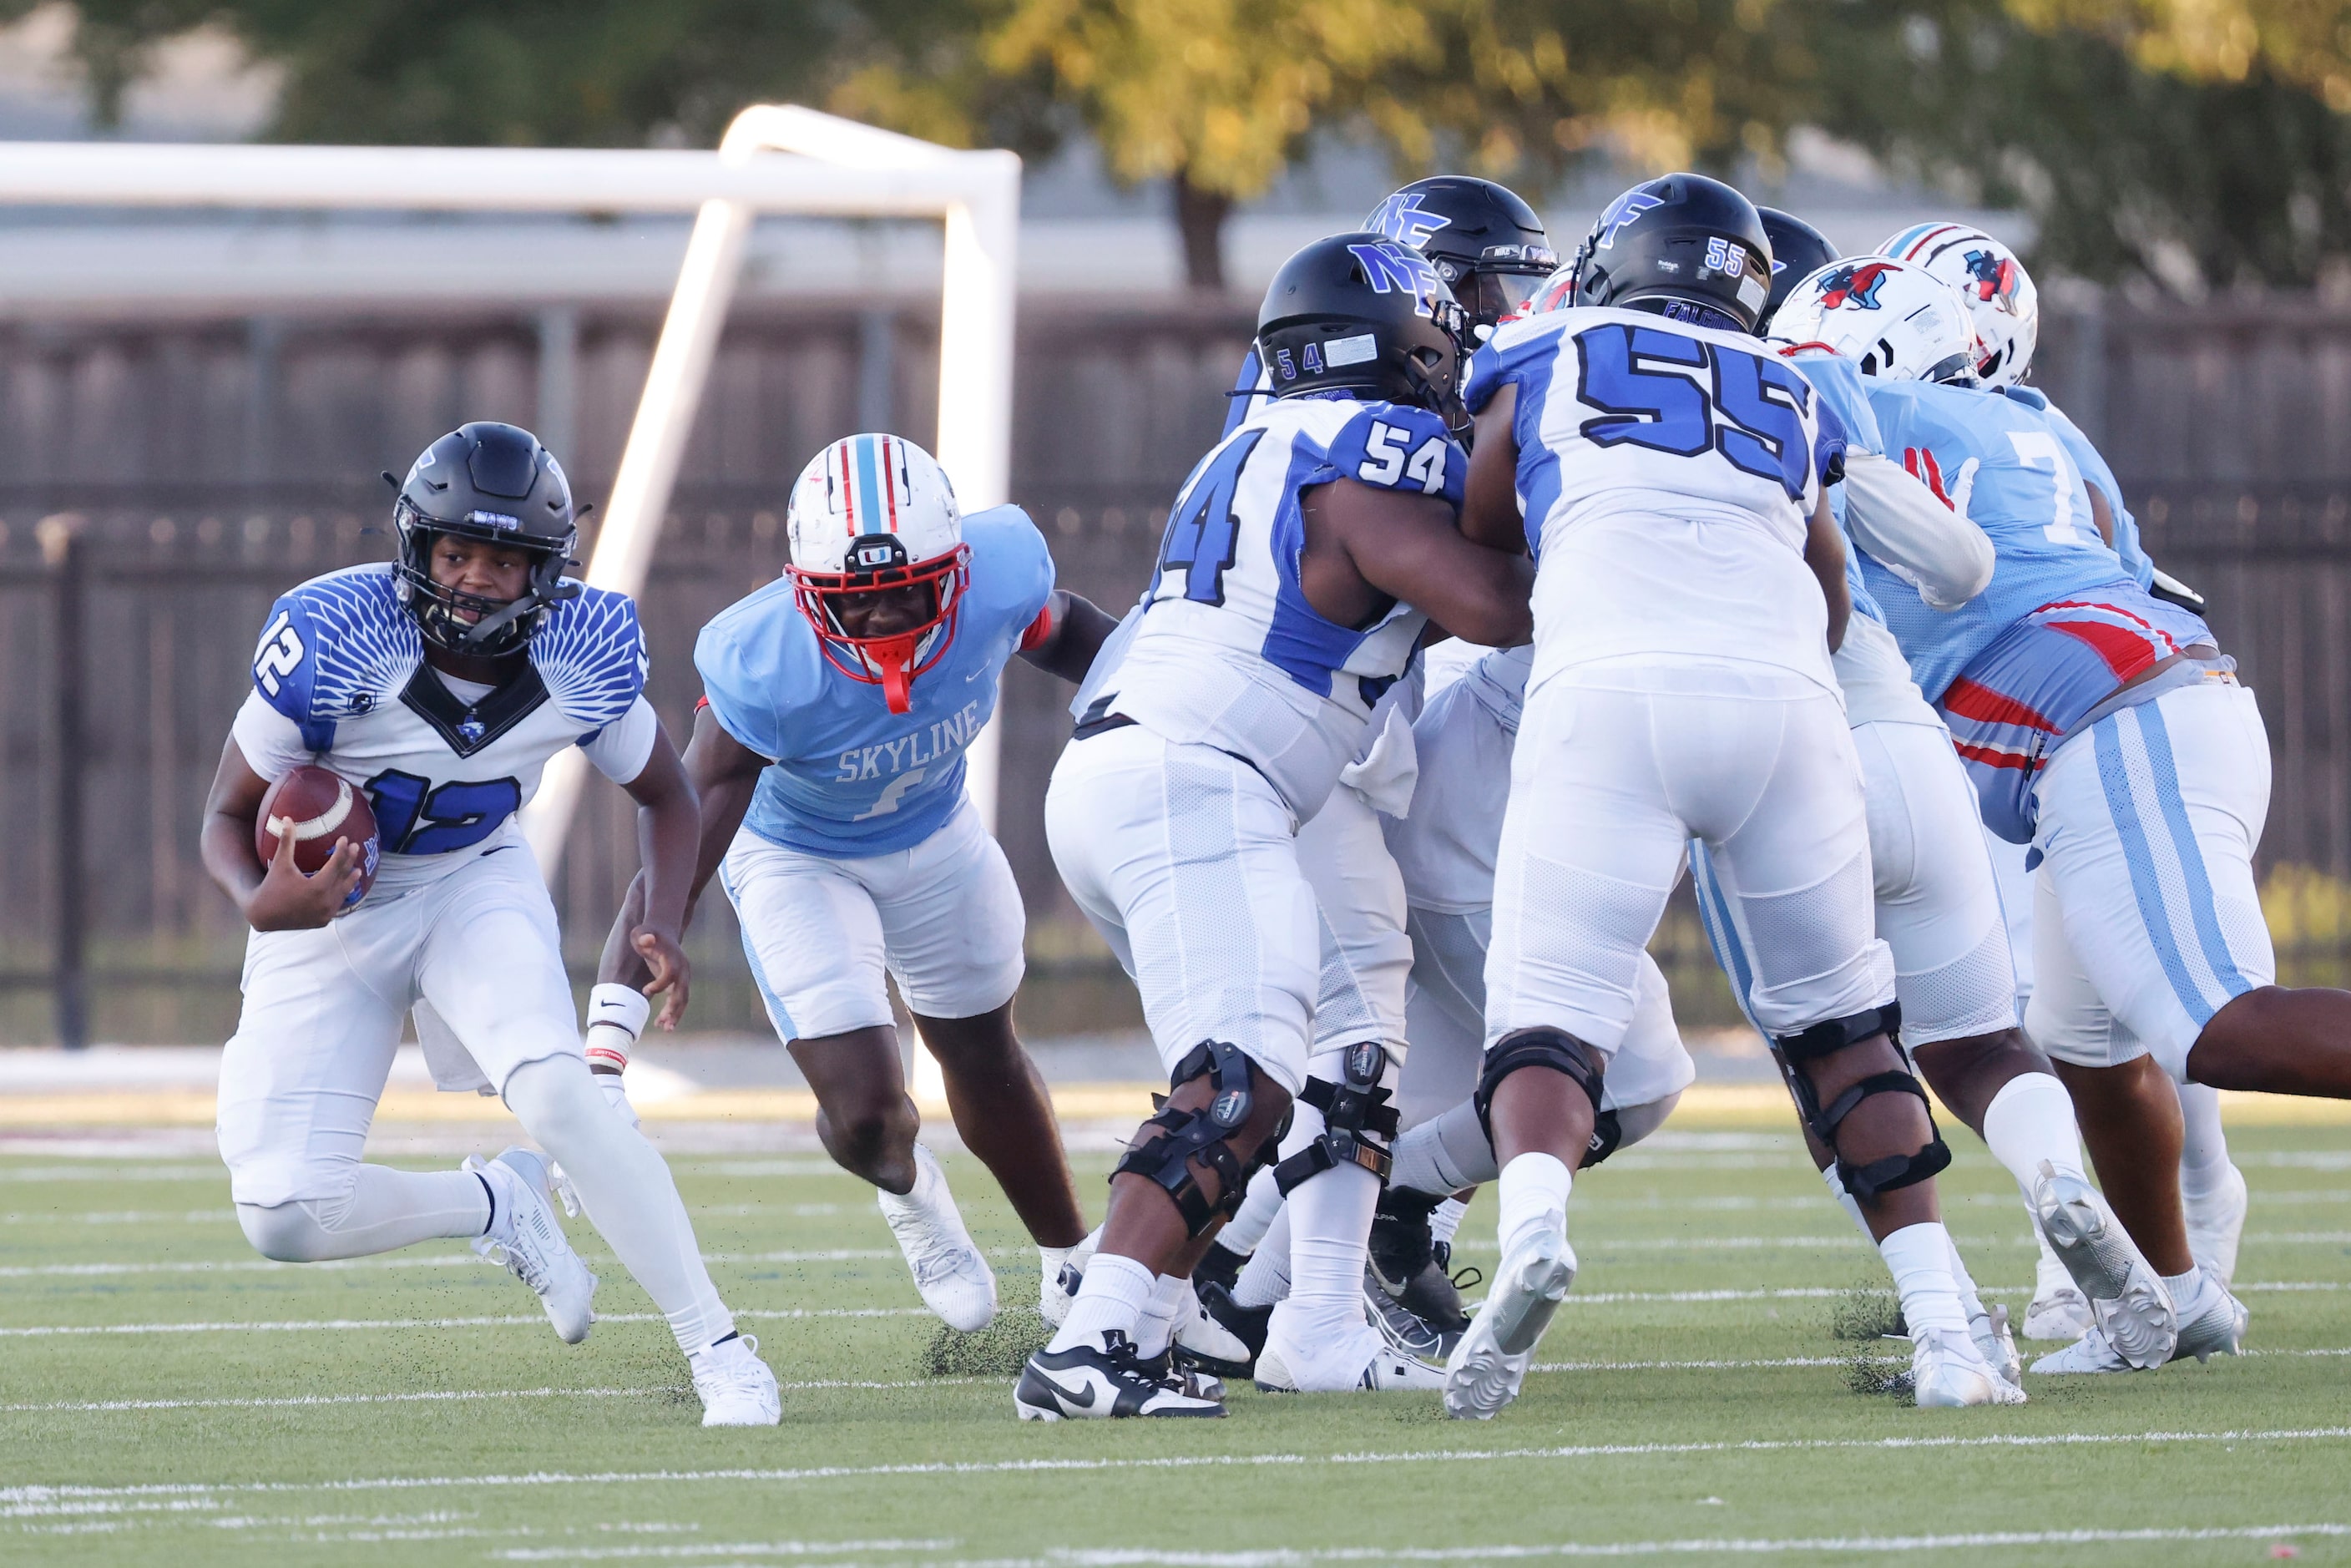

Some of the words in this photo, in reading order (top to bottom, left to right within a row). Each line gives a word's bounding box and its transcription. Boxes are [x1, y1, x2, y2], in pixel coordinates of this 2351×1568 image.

[1347, 243, 1438, 318] NF
[1705, 236, 1747, 278] 55
[1277, 342, 1324, 381] 54
[1571, 322, 1811, 504] 55
[1358, 420, 1449, 495] 54
[2005, 431, 2091, 547] 7
[254, 609, 306, 699] 12
[836, 700, 982, 782] SKYLINE
[363, 767, 522, 856] 12
